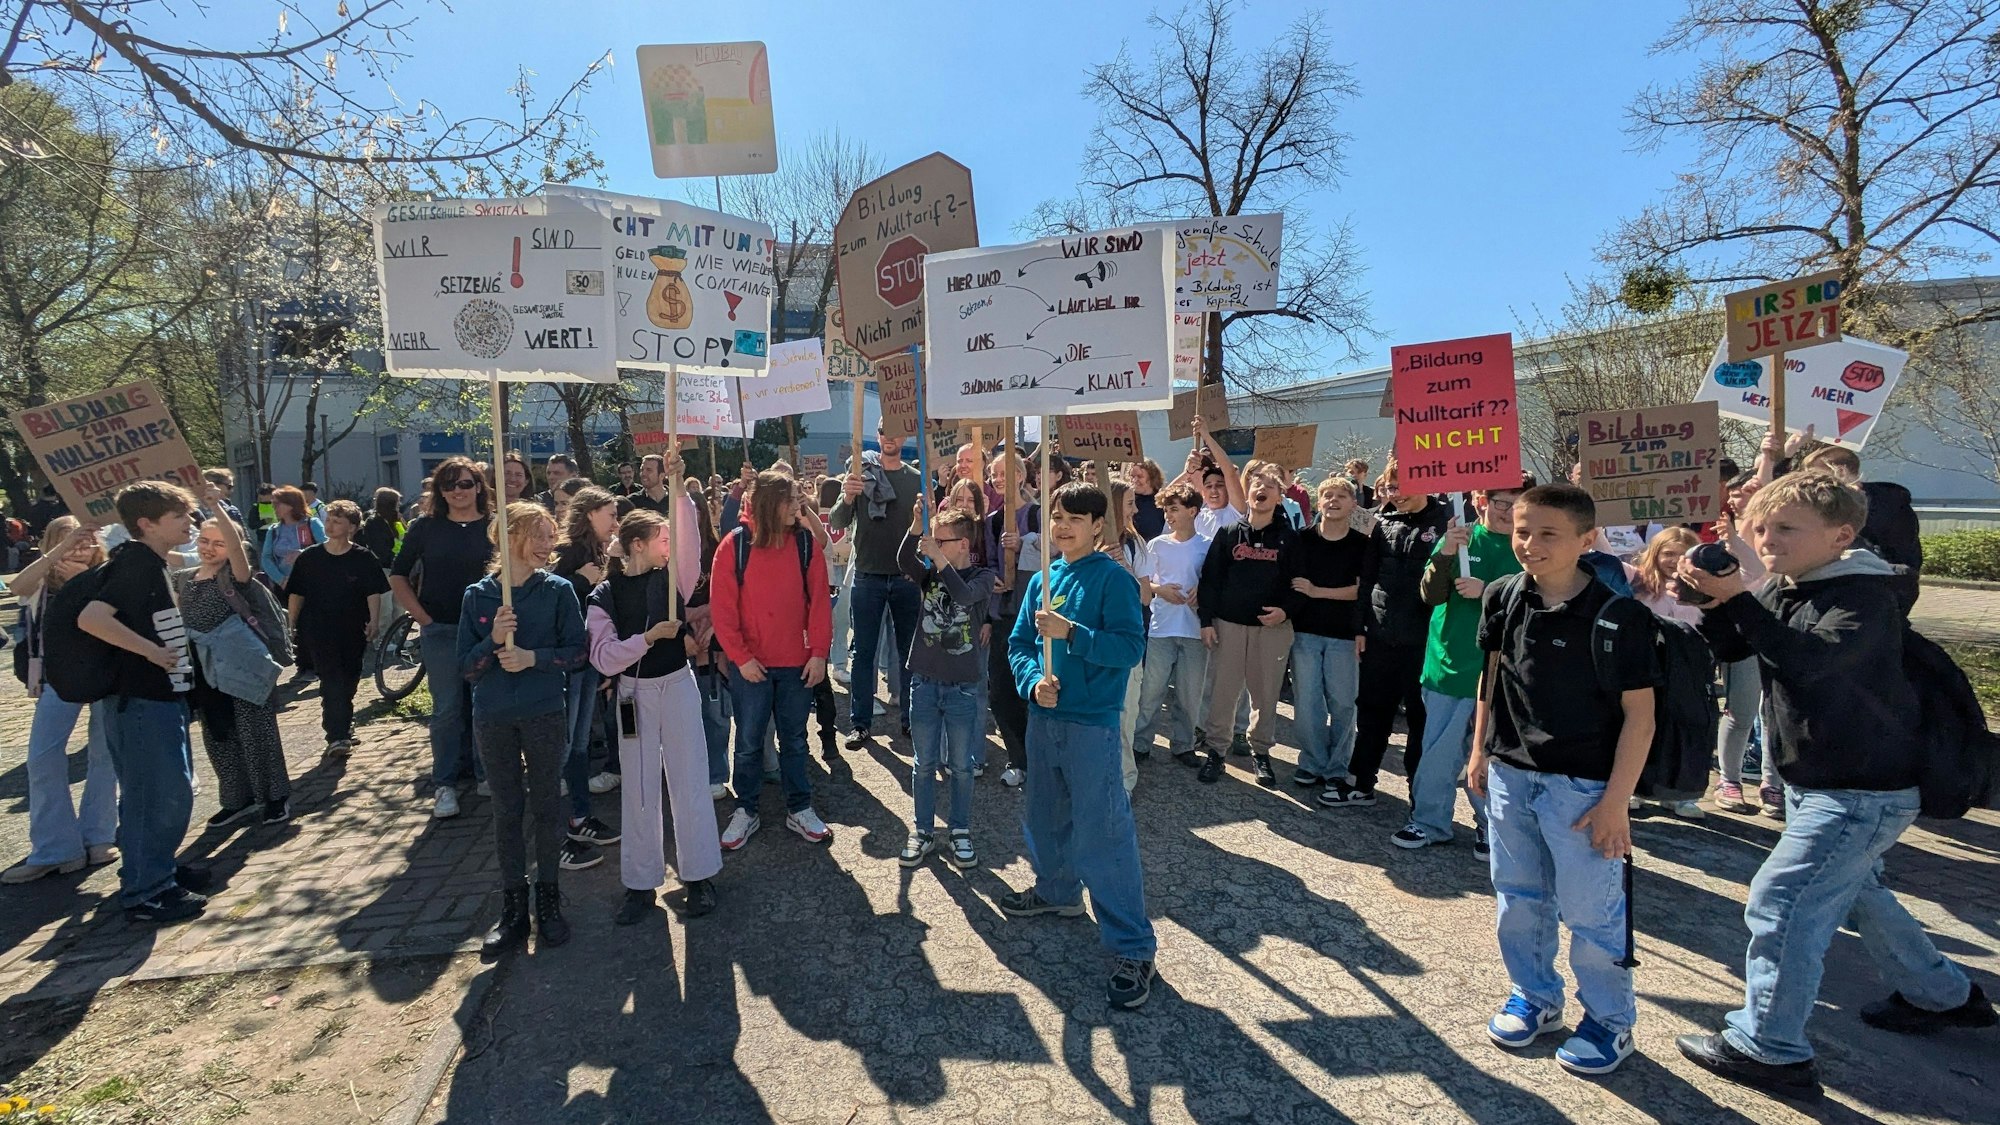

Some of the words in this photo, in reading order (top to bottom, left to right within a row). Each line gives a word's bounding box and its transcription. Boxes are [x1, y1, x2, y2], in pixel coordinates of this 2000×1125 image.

[695, 45, 743, 63] NEUBAU
[858, 183, 923, 221] Bildung
[385, 235, 433, 258] WIR
[532, 226, 575, 249] SIND
[666, 221, 716, 248] MIT
[723, 228, 774, 263] UNS!
[839, 236, 868, 257] zum
[1061, 236, 1100, 258] WIR
[1104, 230, 1143, 253] SIND
[1234, 224, 1280, 271] Schule
[615, 245, 646, 261] GELD
[694, 253, 724, 271] NIE
[731, 257, 774, 277] WIEDER
[1184, 248, 1227, 276] jetzt
[613, 264, 658, 281] HULEN
[694, 273, 772, 298] CONTAINER
[947, 273, 972, 292] HIER
[977, 269, 1002, 288] UND
[1190, 279, 1242, 300] Bildung
[1252, 279, 1272, 292] ist
[1058, 297, 1085, 315] LAUT
[1087, 295, 1116, 312] WEIL
[1124, 295, 1141, 310] IHR
[387, 331, 431, 350] MEHR
[524, 327, 593, 350] WERT!
[855, 317, 892, 349] Nicht
[902, 306, 924, 333] mit
[1746, 304, 1841, 352] JETZT
[629, 328, 733, 368] STOP!
[966, 332, 996, 351] UNS
[1064, 343, 1092, 362] DIE
[1399, 351, 1484, 374] „Bildung
[1845, 366, 1882, 383] STOP
[1426, 377, 1471, 395] zum
[1811, 385, 1855, 406] MEHR
[20, 386, 149, 438] BILDUNG
[44, 418, 176, 475] NULLTARIF?
[933, 434, 958, 449] MIT
[1414, 426, 1503, 450] NICHT
[1620, 438, 1668, 454] zum
[1408, 460, 1448, 480] mit
[1588, 447, 1717, 478] NULLTARIF?
[69, 457, 141, 497] NICHT
[1592, 478, 1661, 499] NICHT
[1666, 473, 1701, 495] mit
[1629, 495, 1712, 518] UNS!!
